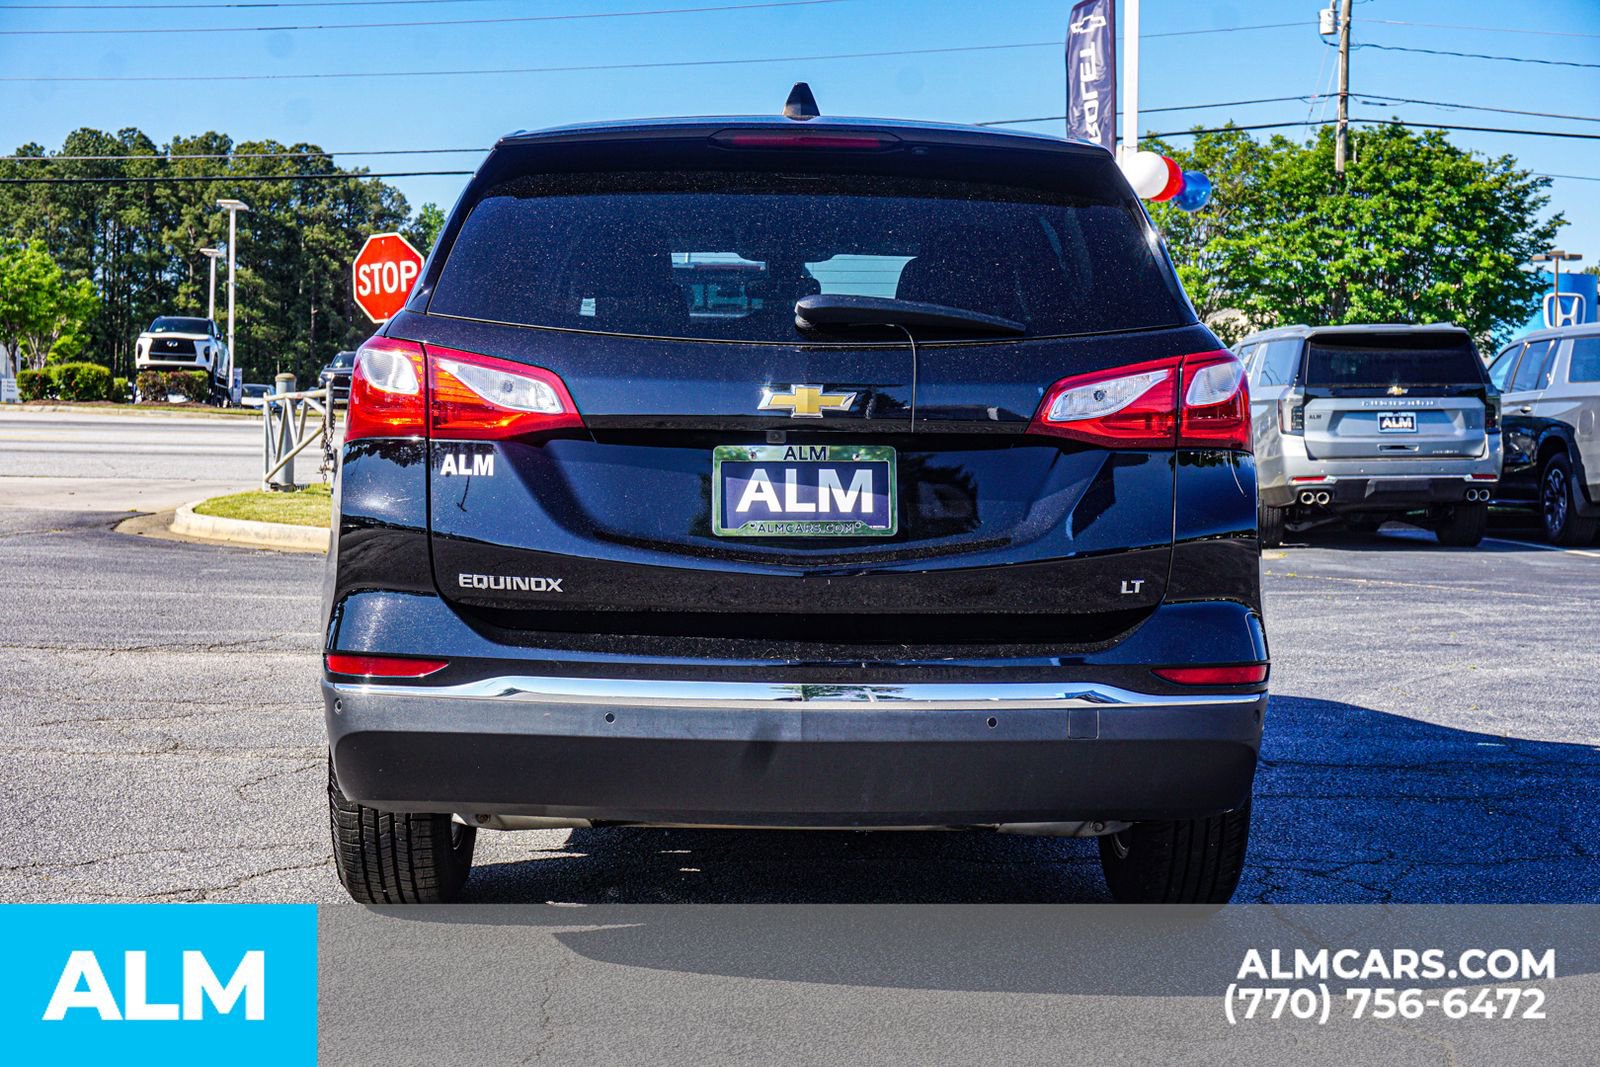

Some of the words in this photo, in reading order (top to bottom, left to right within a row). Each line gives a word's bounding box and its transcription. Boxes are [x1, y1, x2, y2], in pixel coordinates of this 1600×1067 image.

[358, 260, 418, 296] STOP
[1382, 417, 1412, 428] ALM
[784, 446, 827, 461] ALM
[440, 454, 494, 476] ALM
[736, 468, 874, 514] ALM
[757, 524, 856, 534] ALMCARS.COM
[458, 573, 563, 592] EQUINOX
[1121, 580, 1144, 594] LT
